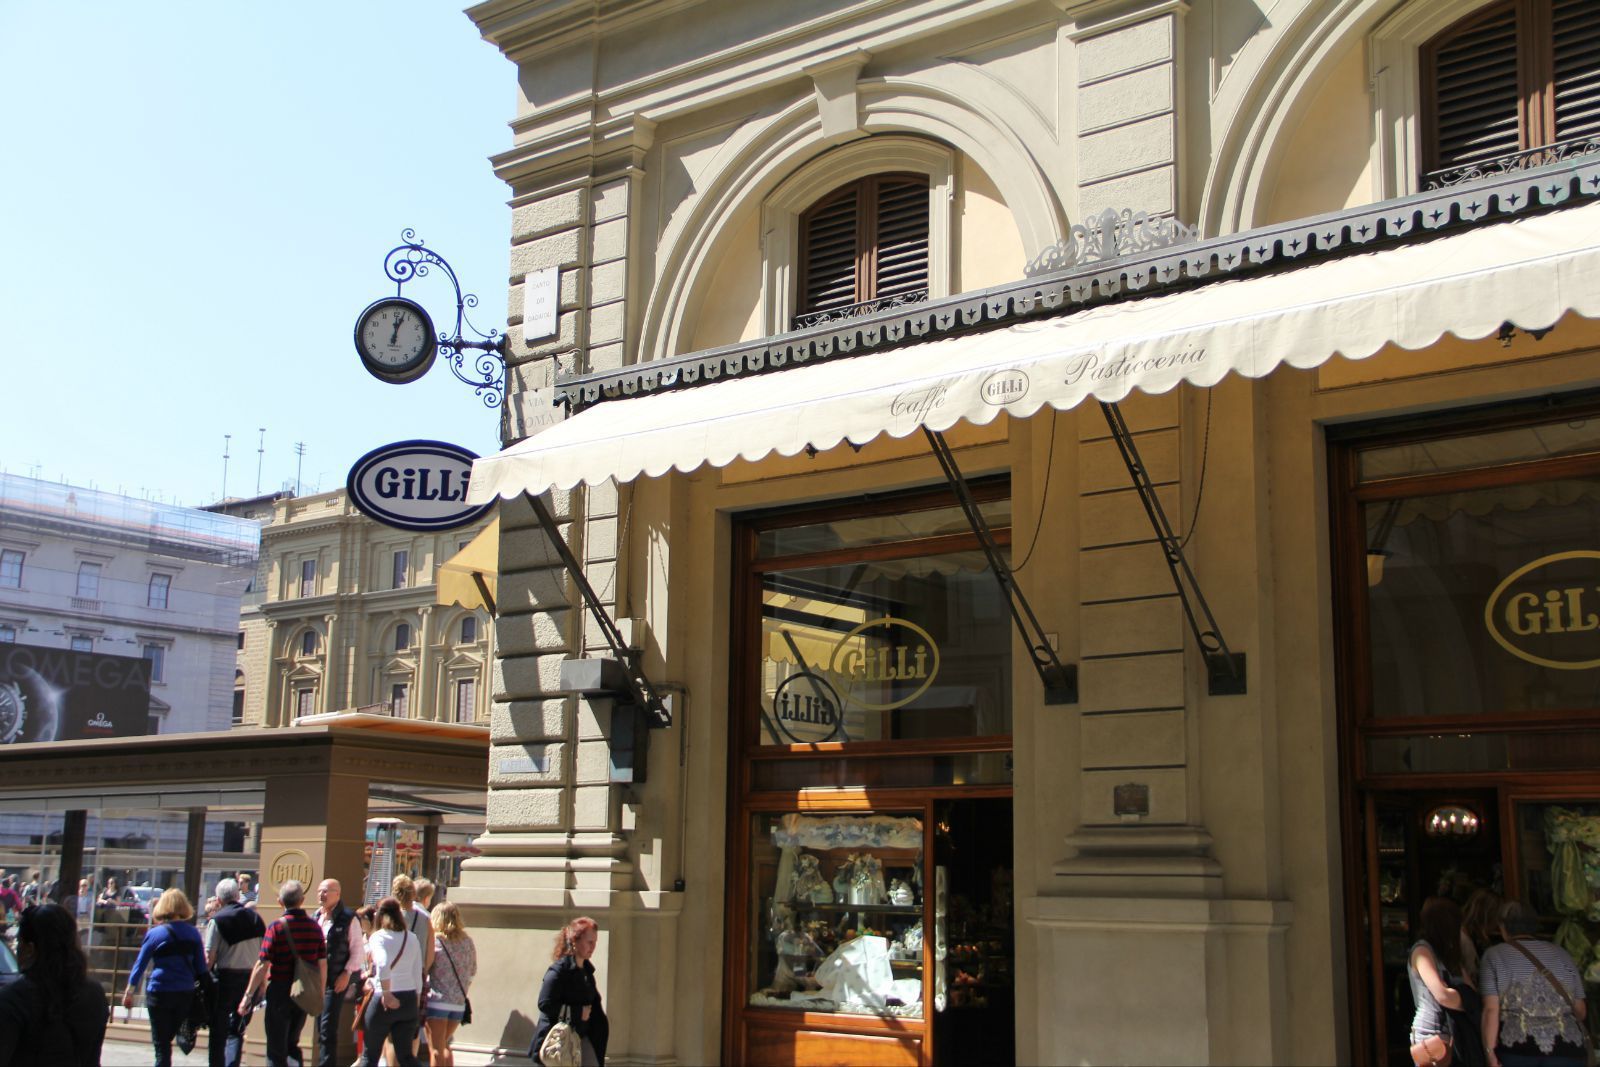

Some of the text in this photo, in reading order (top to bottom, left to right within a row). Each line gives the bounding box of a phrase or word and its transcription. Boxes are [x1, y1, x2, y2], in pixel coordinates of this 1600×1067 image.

[1064, 344, 1207, 386] Pasticceria
[528, 397, 545, 407] VIA
[1505, 588, 1600, 636] GiL
[6, 648, 147, 691] OMEGA
[87, 719, 113, 728] OMEGA
